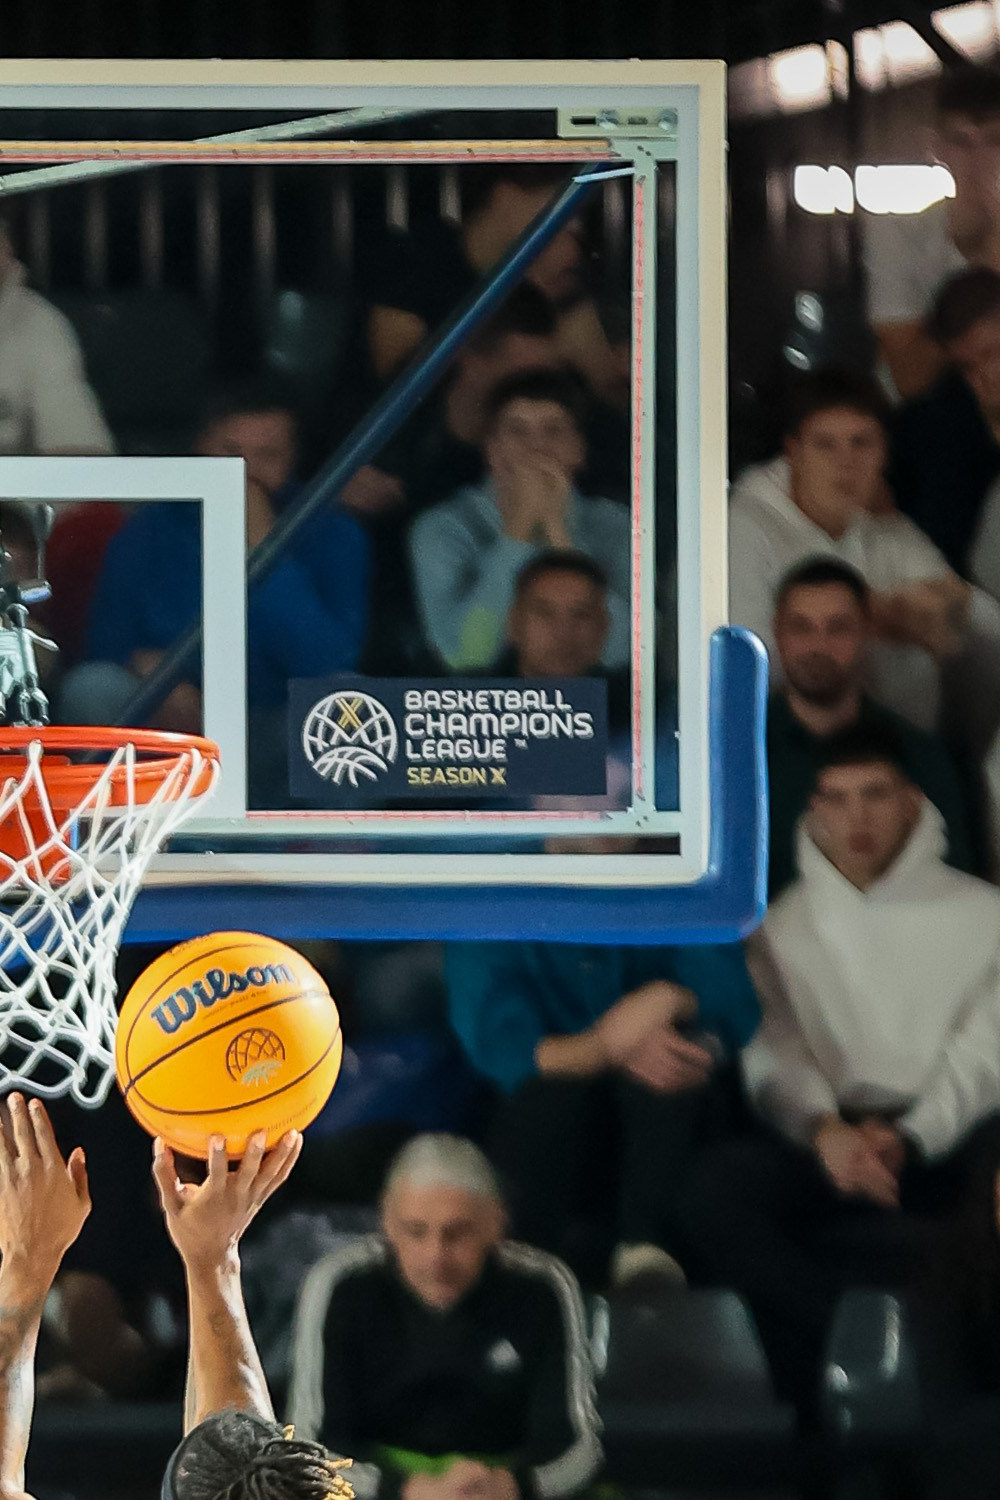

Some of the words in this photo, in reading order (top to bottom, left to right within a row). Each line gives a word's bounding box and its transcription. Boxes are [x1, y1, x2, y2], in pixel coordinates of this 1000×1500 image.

[404, 689, 572, 712] BASKETBALL
[404, 712, 595, 739] CHAMPIONS
[405, 738, 507, 762] LEAGUE
[407, 766, 486, 788] SEASON
[489, 766, 507, 787] X
[150, 962, 297, 1035] Wilson
